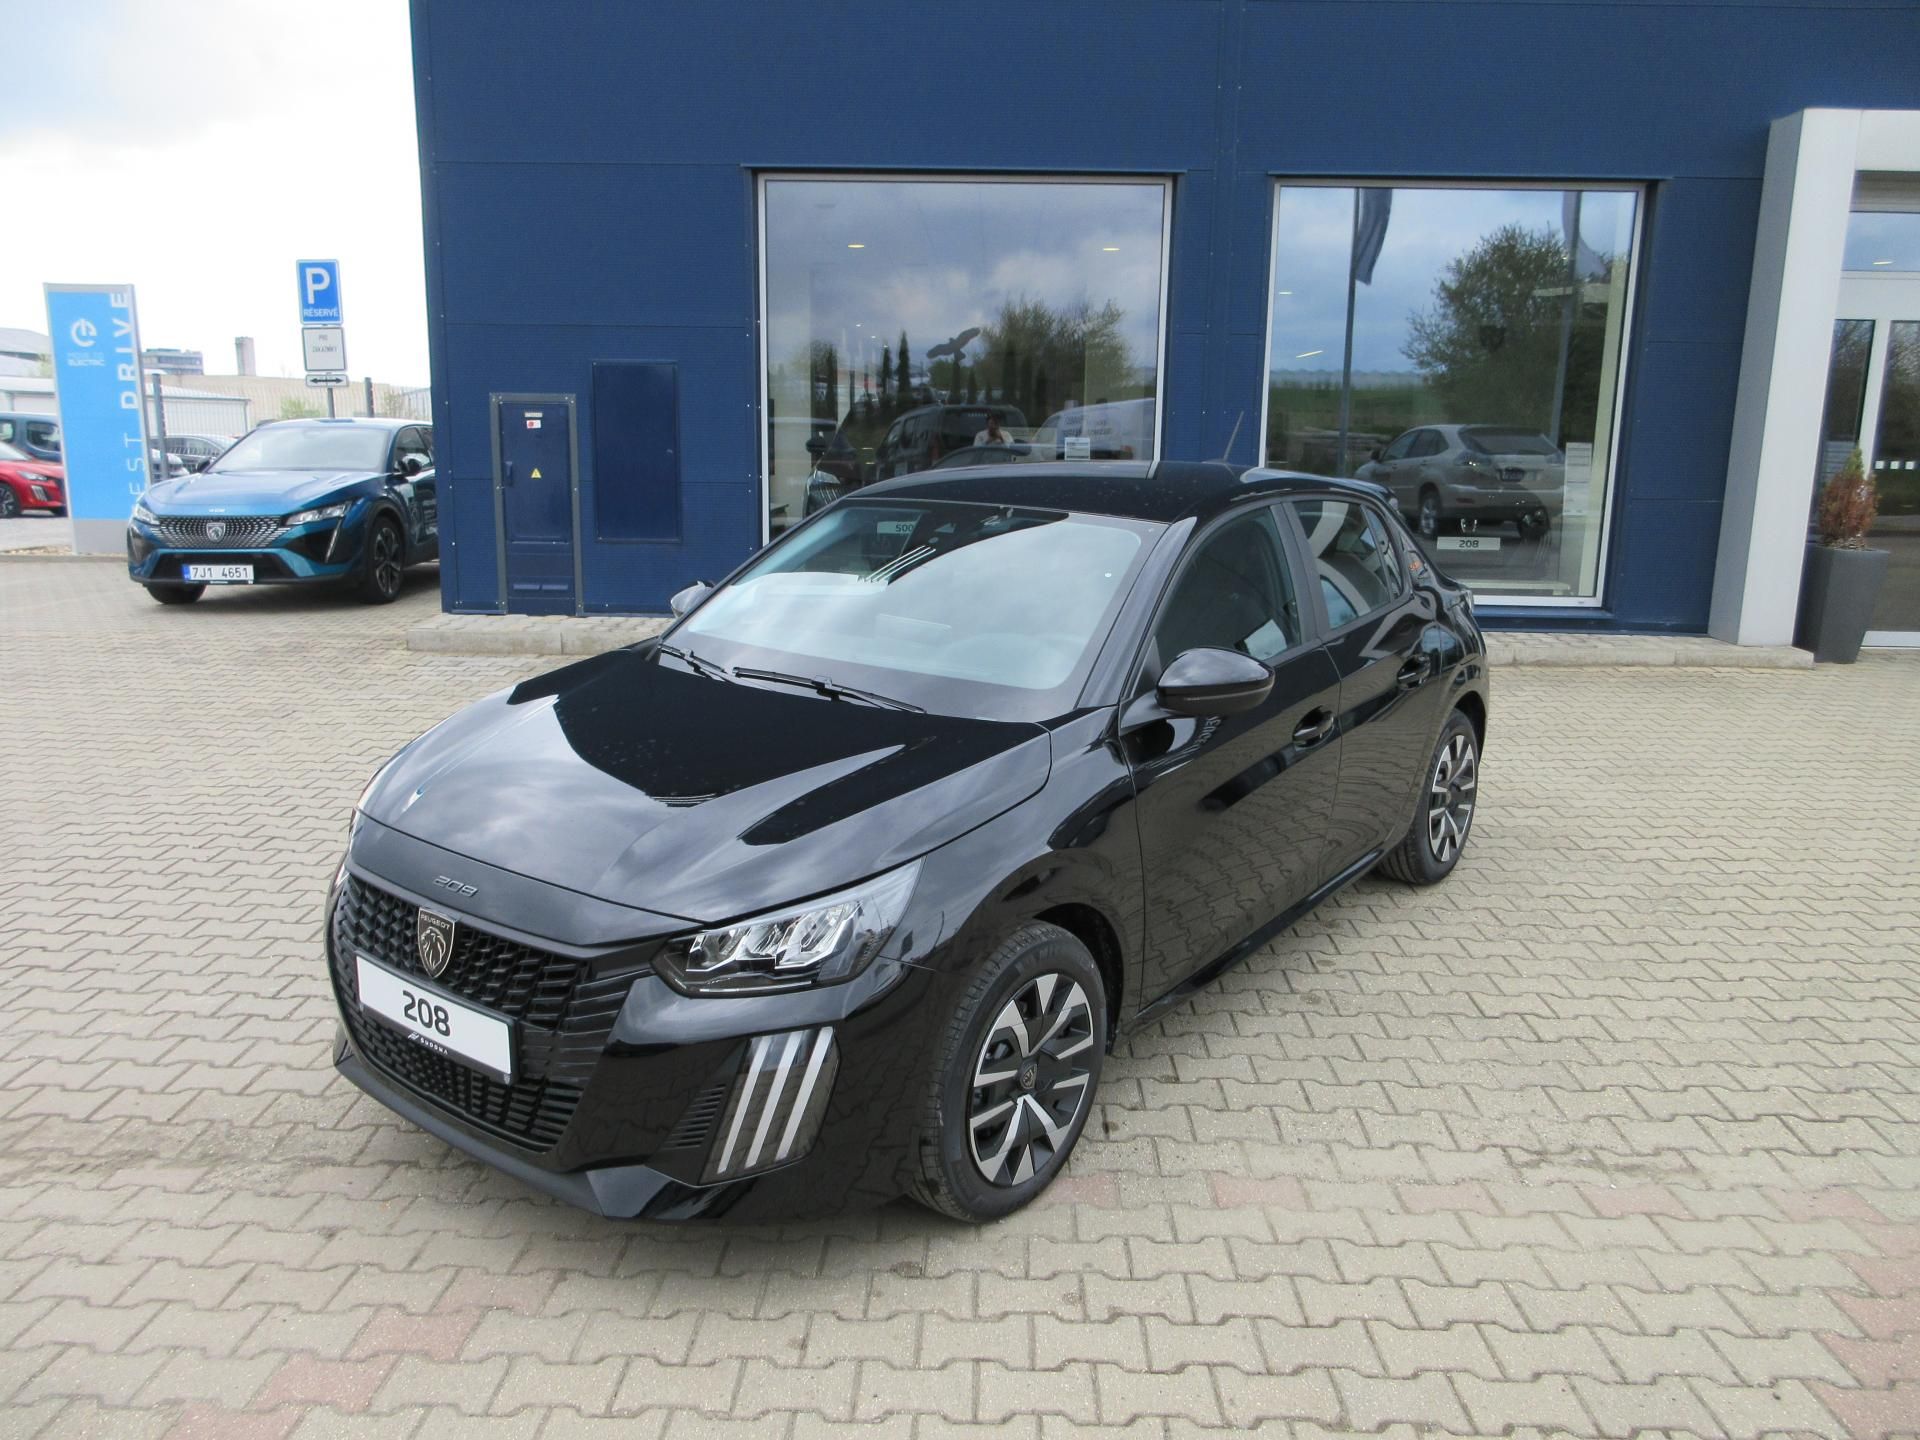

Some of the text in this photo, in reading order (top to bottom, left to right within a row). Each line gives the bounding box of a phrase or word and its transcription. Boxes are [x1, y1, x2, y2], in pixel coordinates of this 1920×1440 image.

[305, 267, 330, 304] P
[111, 292, 139, 409] DRIVE
[1458, 539, 1479, 548] 208
[192, 567, 213, 578] 7J1
[222, 567, 249, 578] 4651
[433, 875, 478, 897] 208
[420, 914, 450, 930] PEUGEOT
[403, 990, 451, 1037] 208
